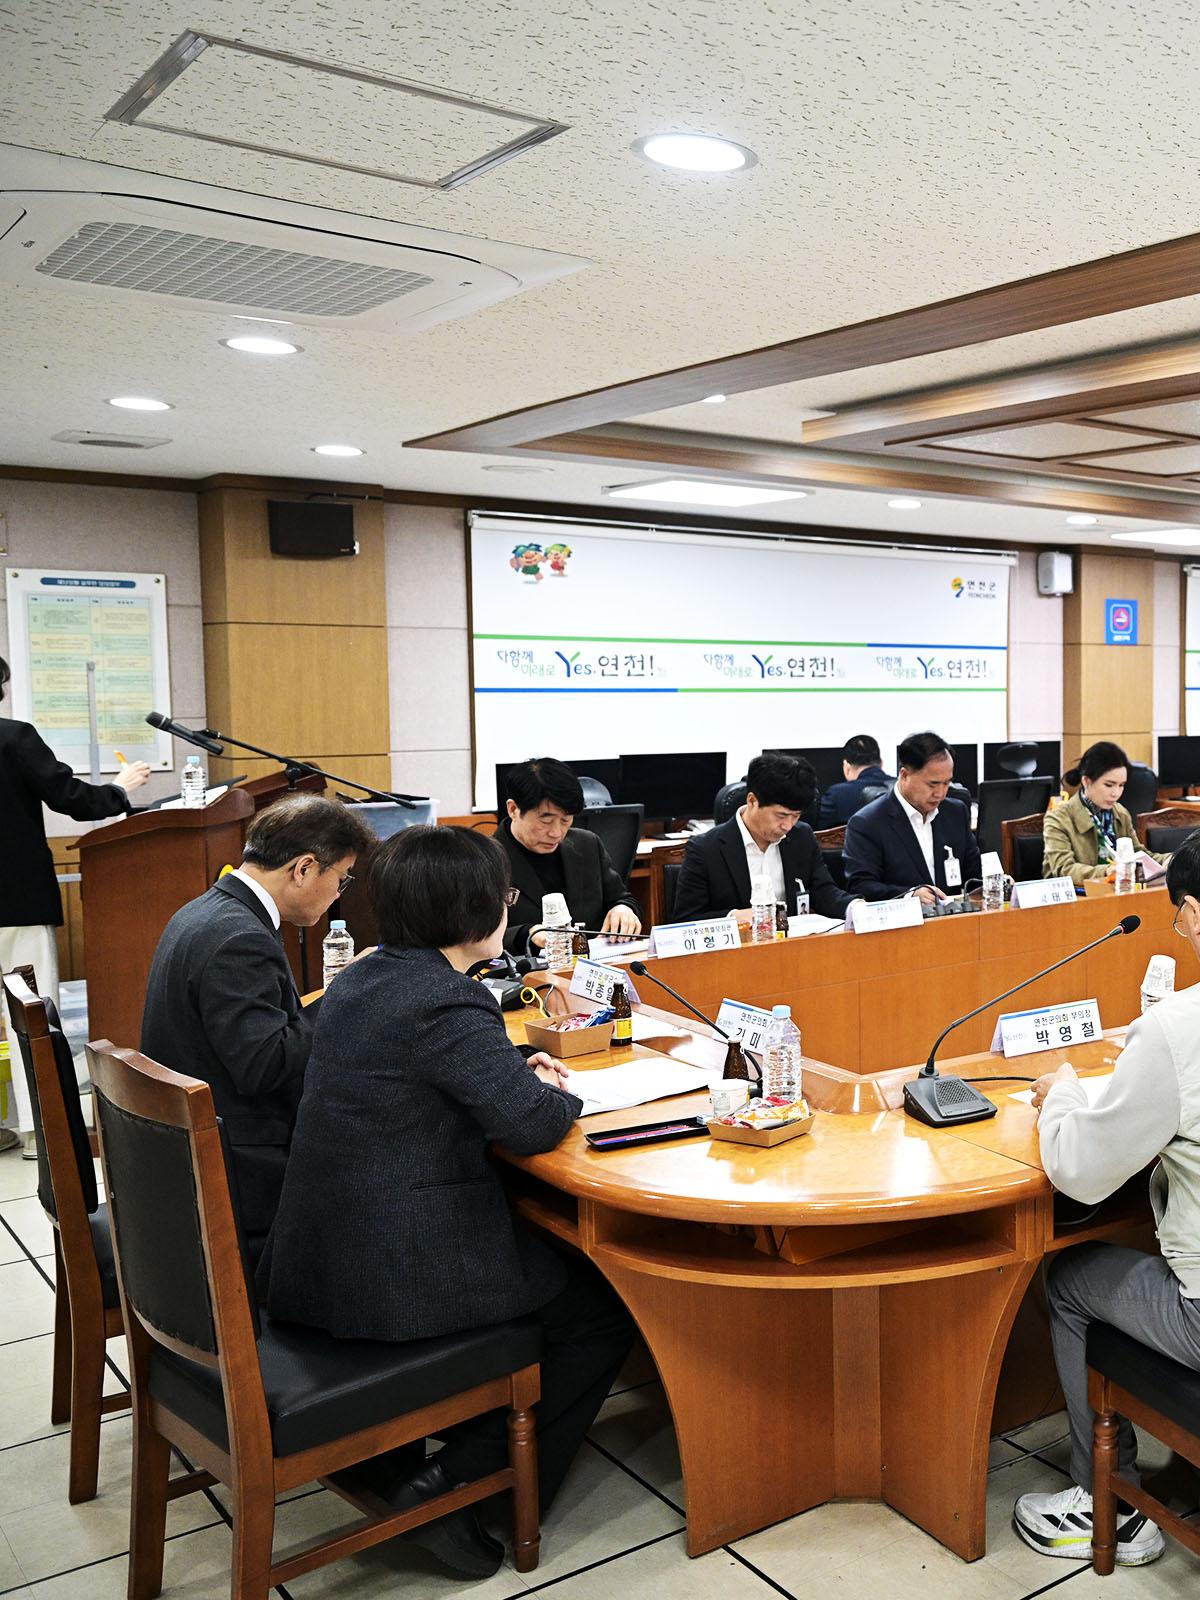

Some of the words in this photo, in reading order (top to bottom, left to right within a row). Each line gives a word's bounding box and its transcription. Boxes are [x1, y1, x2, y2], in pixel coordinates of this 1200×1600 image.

[497, 650, 534, 668] 다함께
[703, 653, 734, 671] 다함께
[1033, 1013, 1069, 1028] 연천군의회
